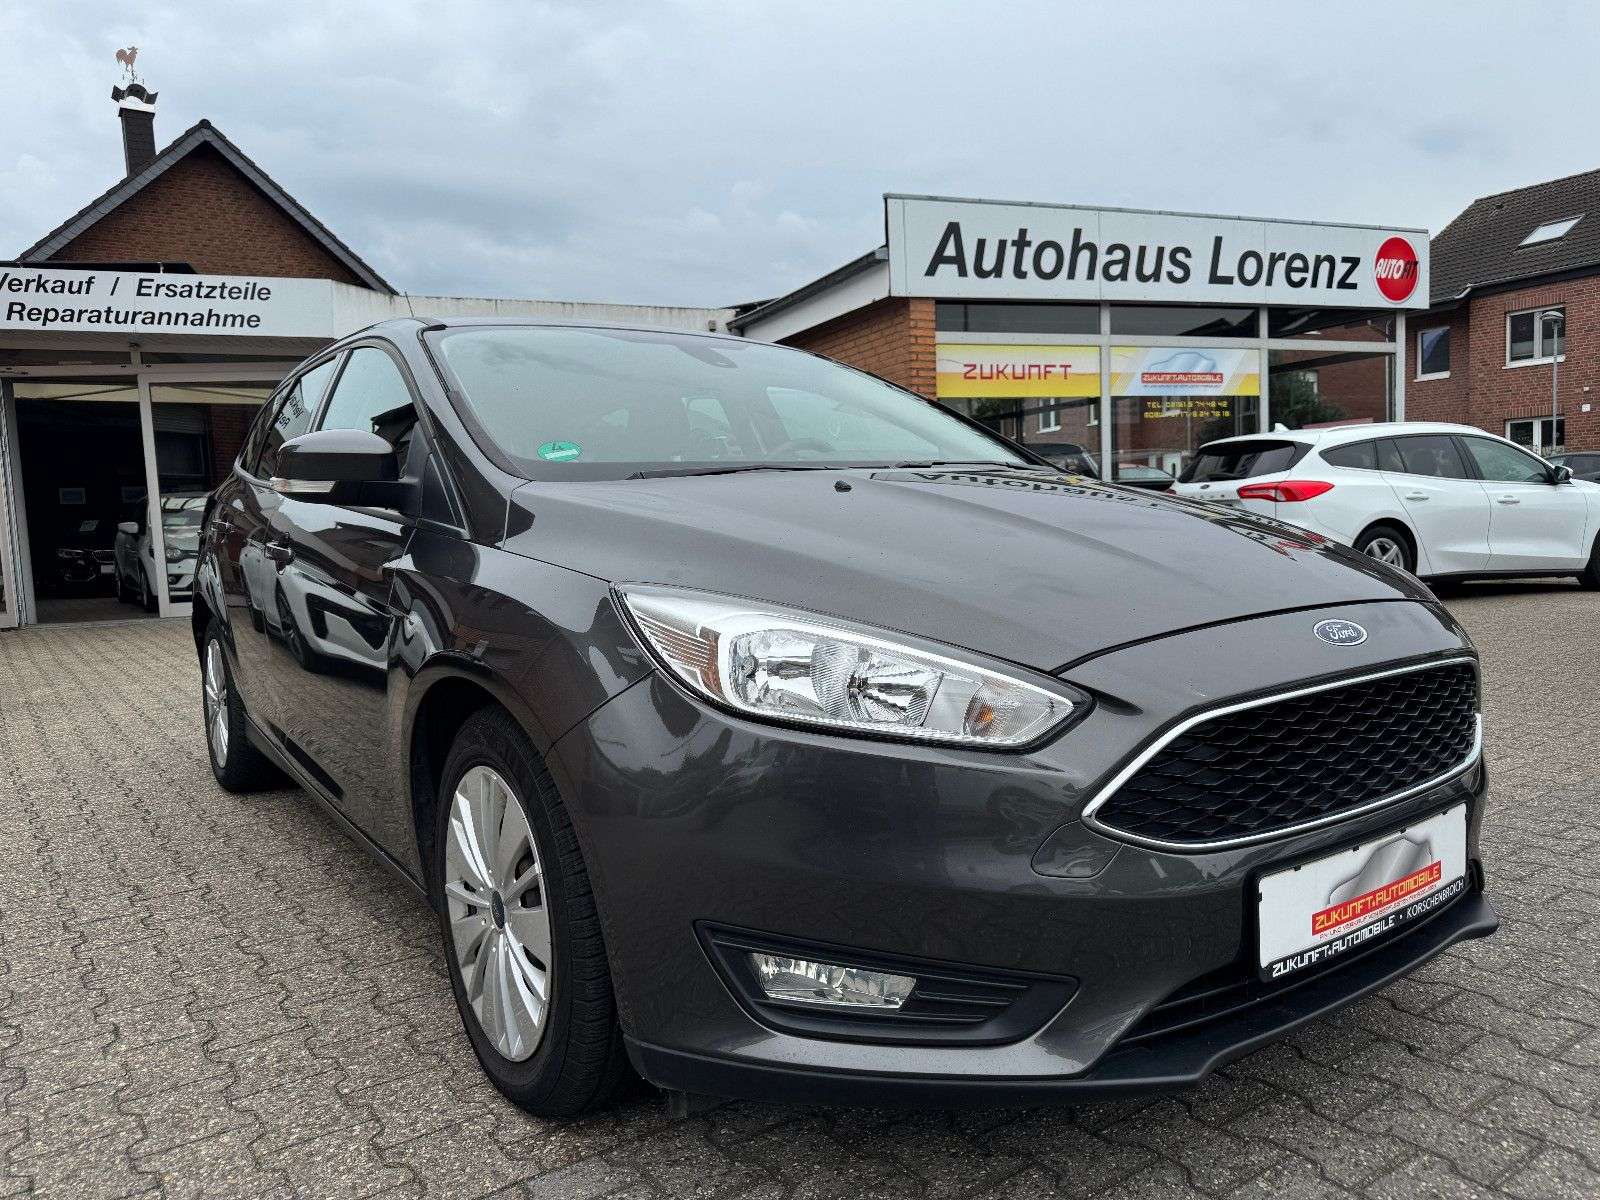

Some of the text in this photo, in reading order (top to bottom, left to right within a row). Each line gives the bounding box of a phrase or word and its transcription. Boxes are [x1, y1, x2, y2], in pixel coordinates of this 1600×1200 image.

[925, 221, 1361, 290] Autohaus Lorenz
[135, 278, 272, 301] Ersatzteile
[6, 301, 261, 329] Reparaturannahme
[963, 363, 1072, 381] ZUKUNFT
[1326, 624, 1356, 639] Ford
[1315, 865, 1440, 931] ZUKUNFT.AUTOMOBILE
[1271, 917, 1396, 978] ZUKUNFT.AUTOMOBILE
[1405, 878, 1465, 920] KORSCHENBROICH
